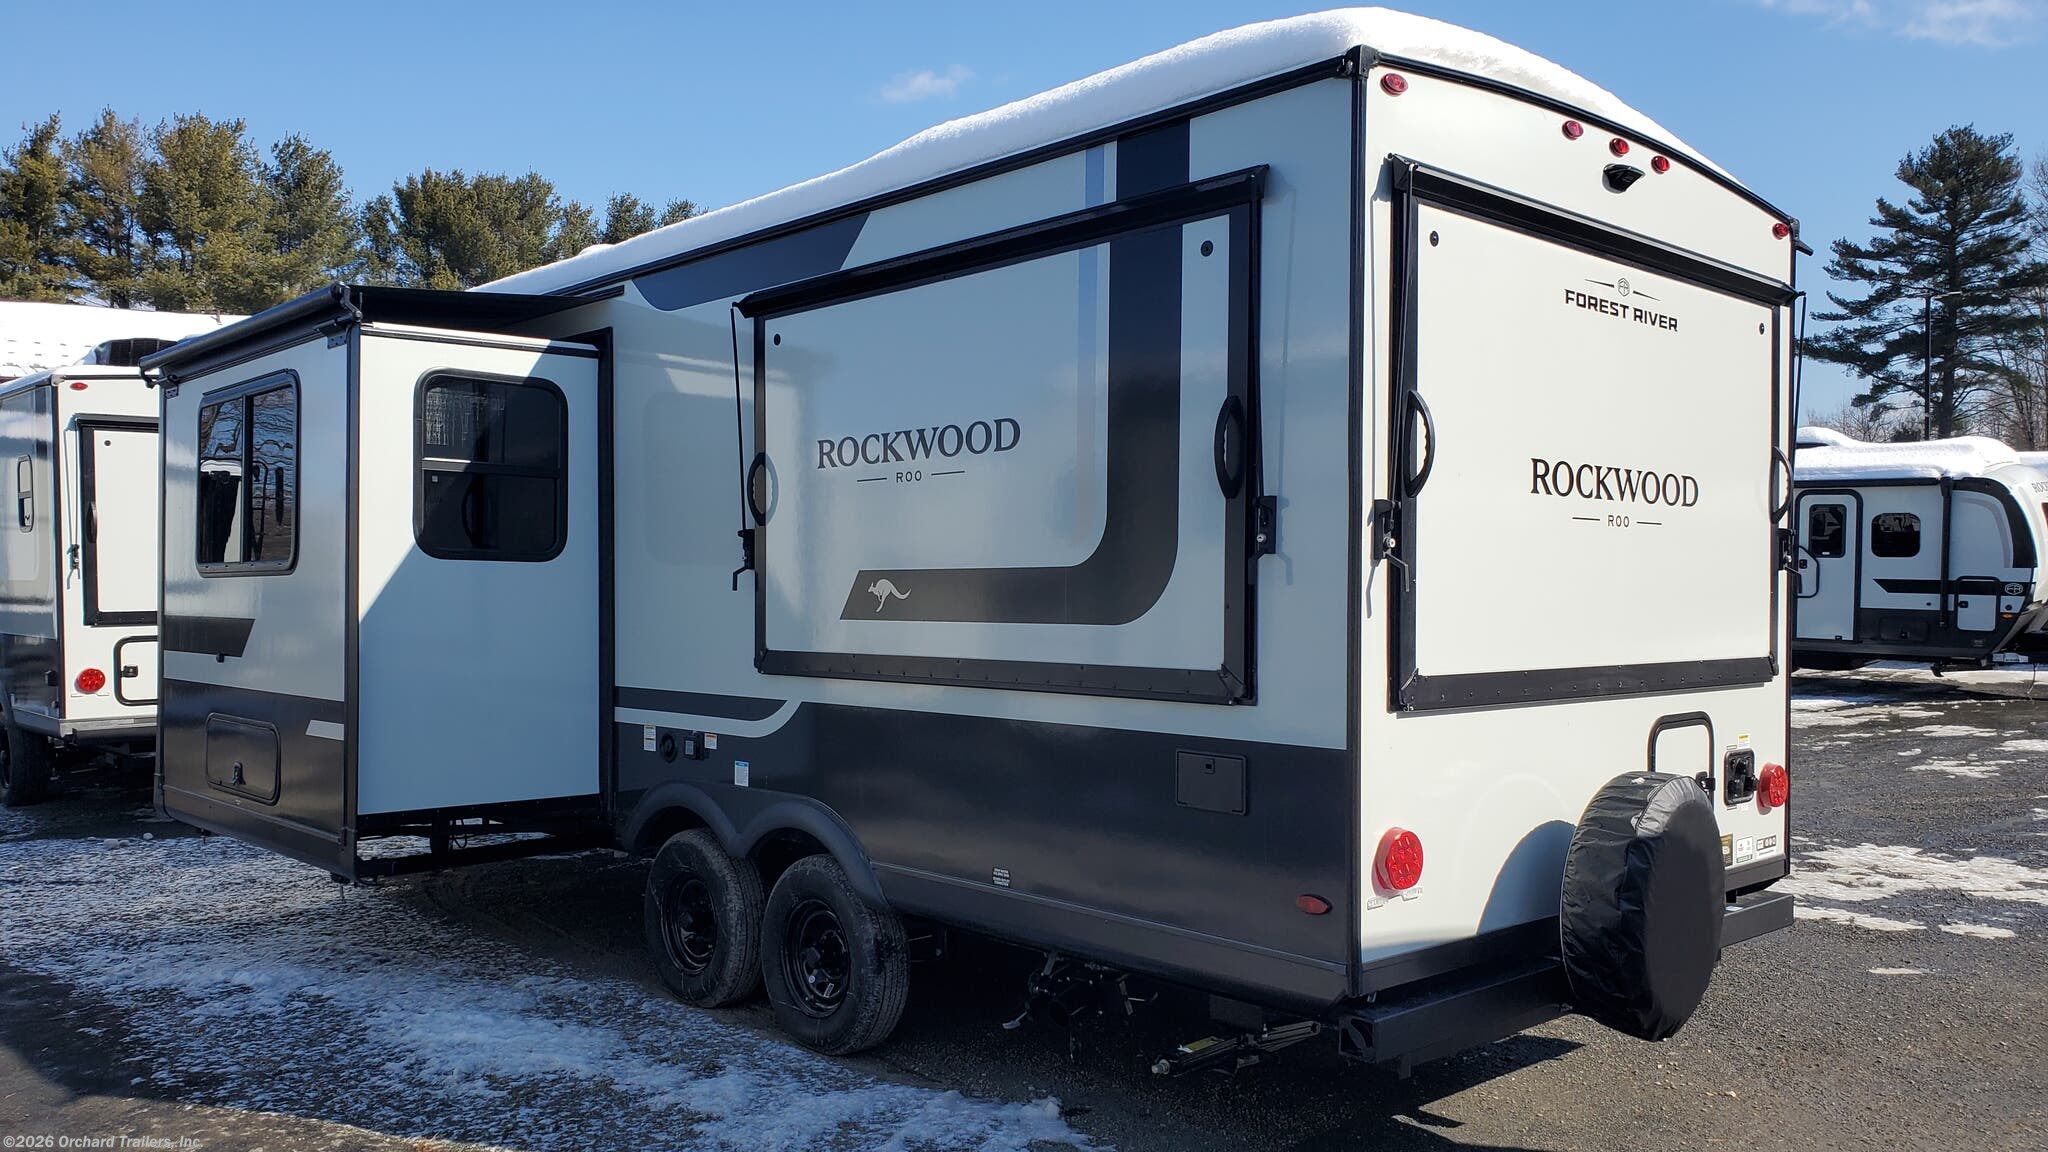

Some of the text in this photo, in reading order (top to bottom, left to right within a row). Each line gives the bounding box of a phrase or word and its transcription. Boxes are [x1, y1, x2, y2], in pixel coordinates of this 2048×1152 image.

[1564, 288, 1678, 332] FOREST RIVER
[816, 417, 1021, 470] ROCKWOOD
[896, 470, 923, 484] ROO
[1530, 457, 1699, 508] ROCKWOOD
[1607, 514, 1630, 528] ROO
